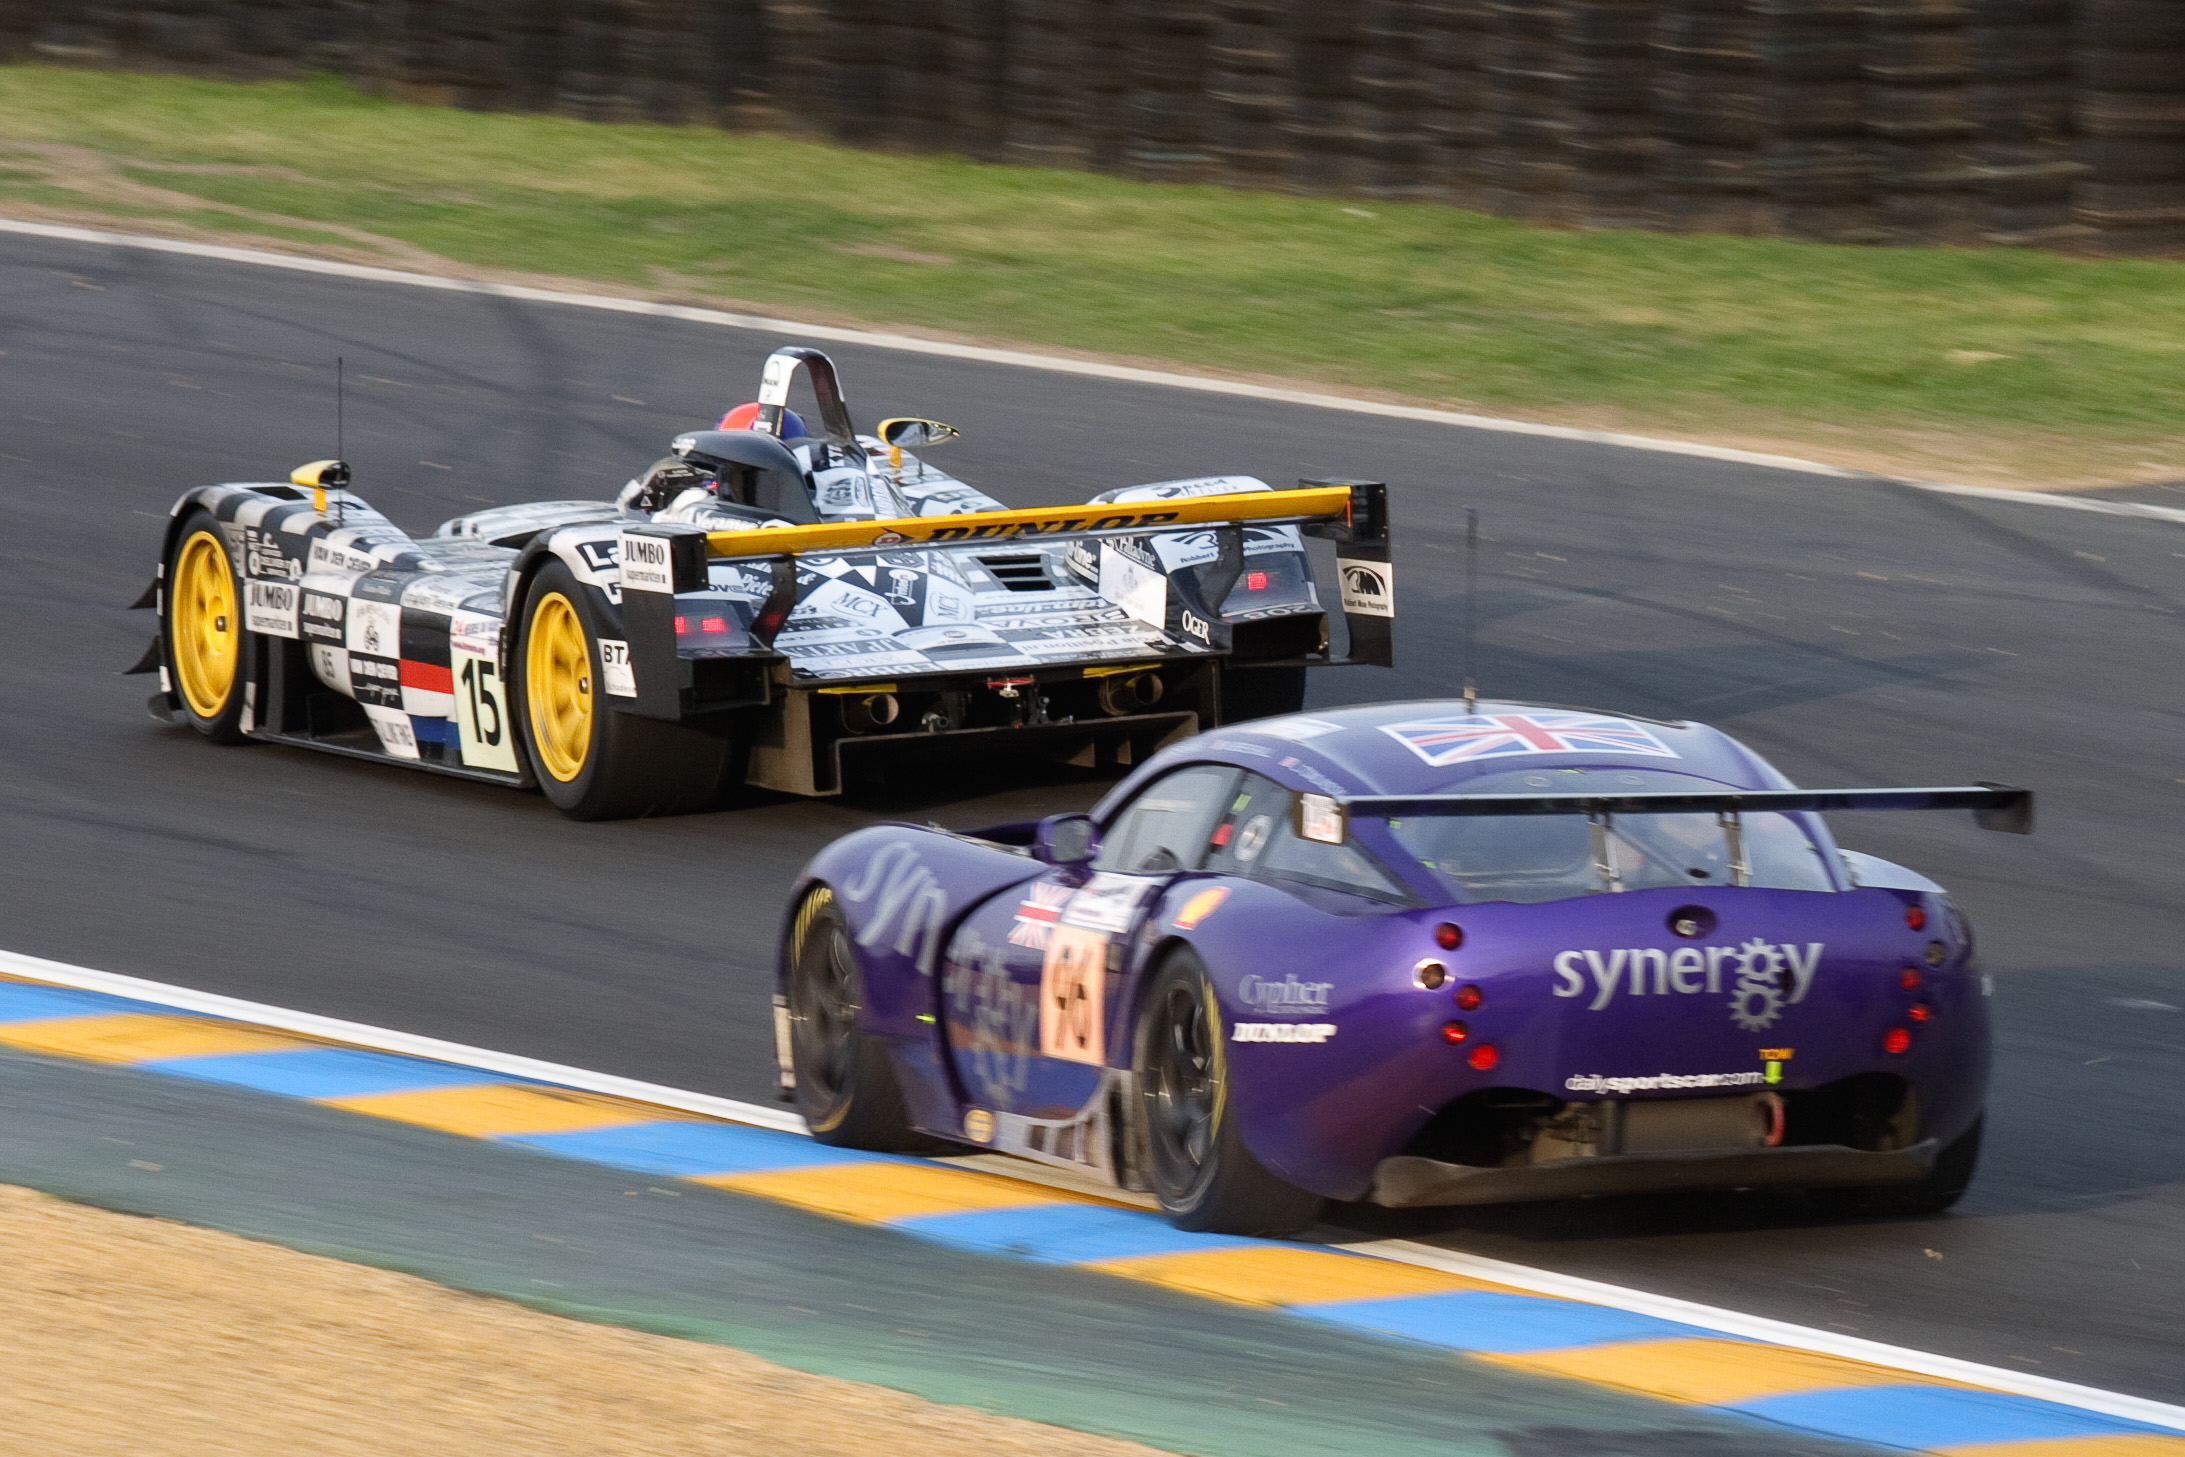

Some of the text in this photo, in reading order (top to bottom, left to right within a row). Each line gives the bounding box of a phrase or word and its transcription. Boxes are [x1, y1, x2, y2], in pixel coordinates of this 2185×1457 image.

[624, 540, 665, 565] JUMBO
[250, 583, 293, 611] JUMBO
[302, 593, 343, 621] JUMBO
[835, 592, 887, 617] MCX
[1042, 623, 1140, 639] ZEBRA
[1182, 610, 1210, 645] OGER
[603, 644, 631, 665] BT
[461, 658, 500, 746] 15
[1552, 938, 1825, 1032] synergy
